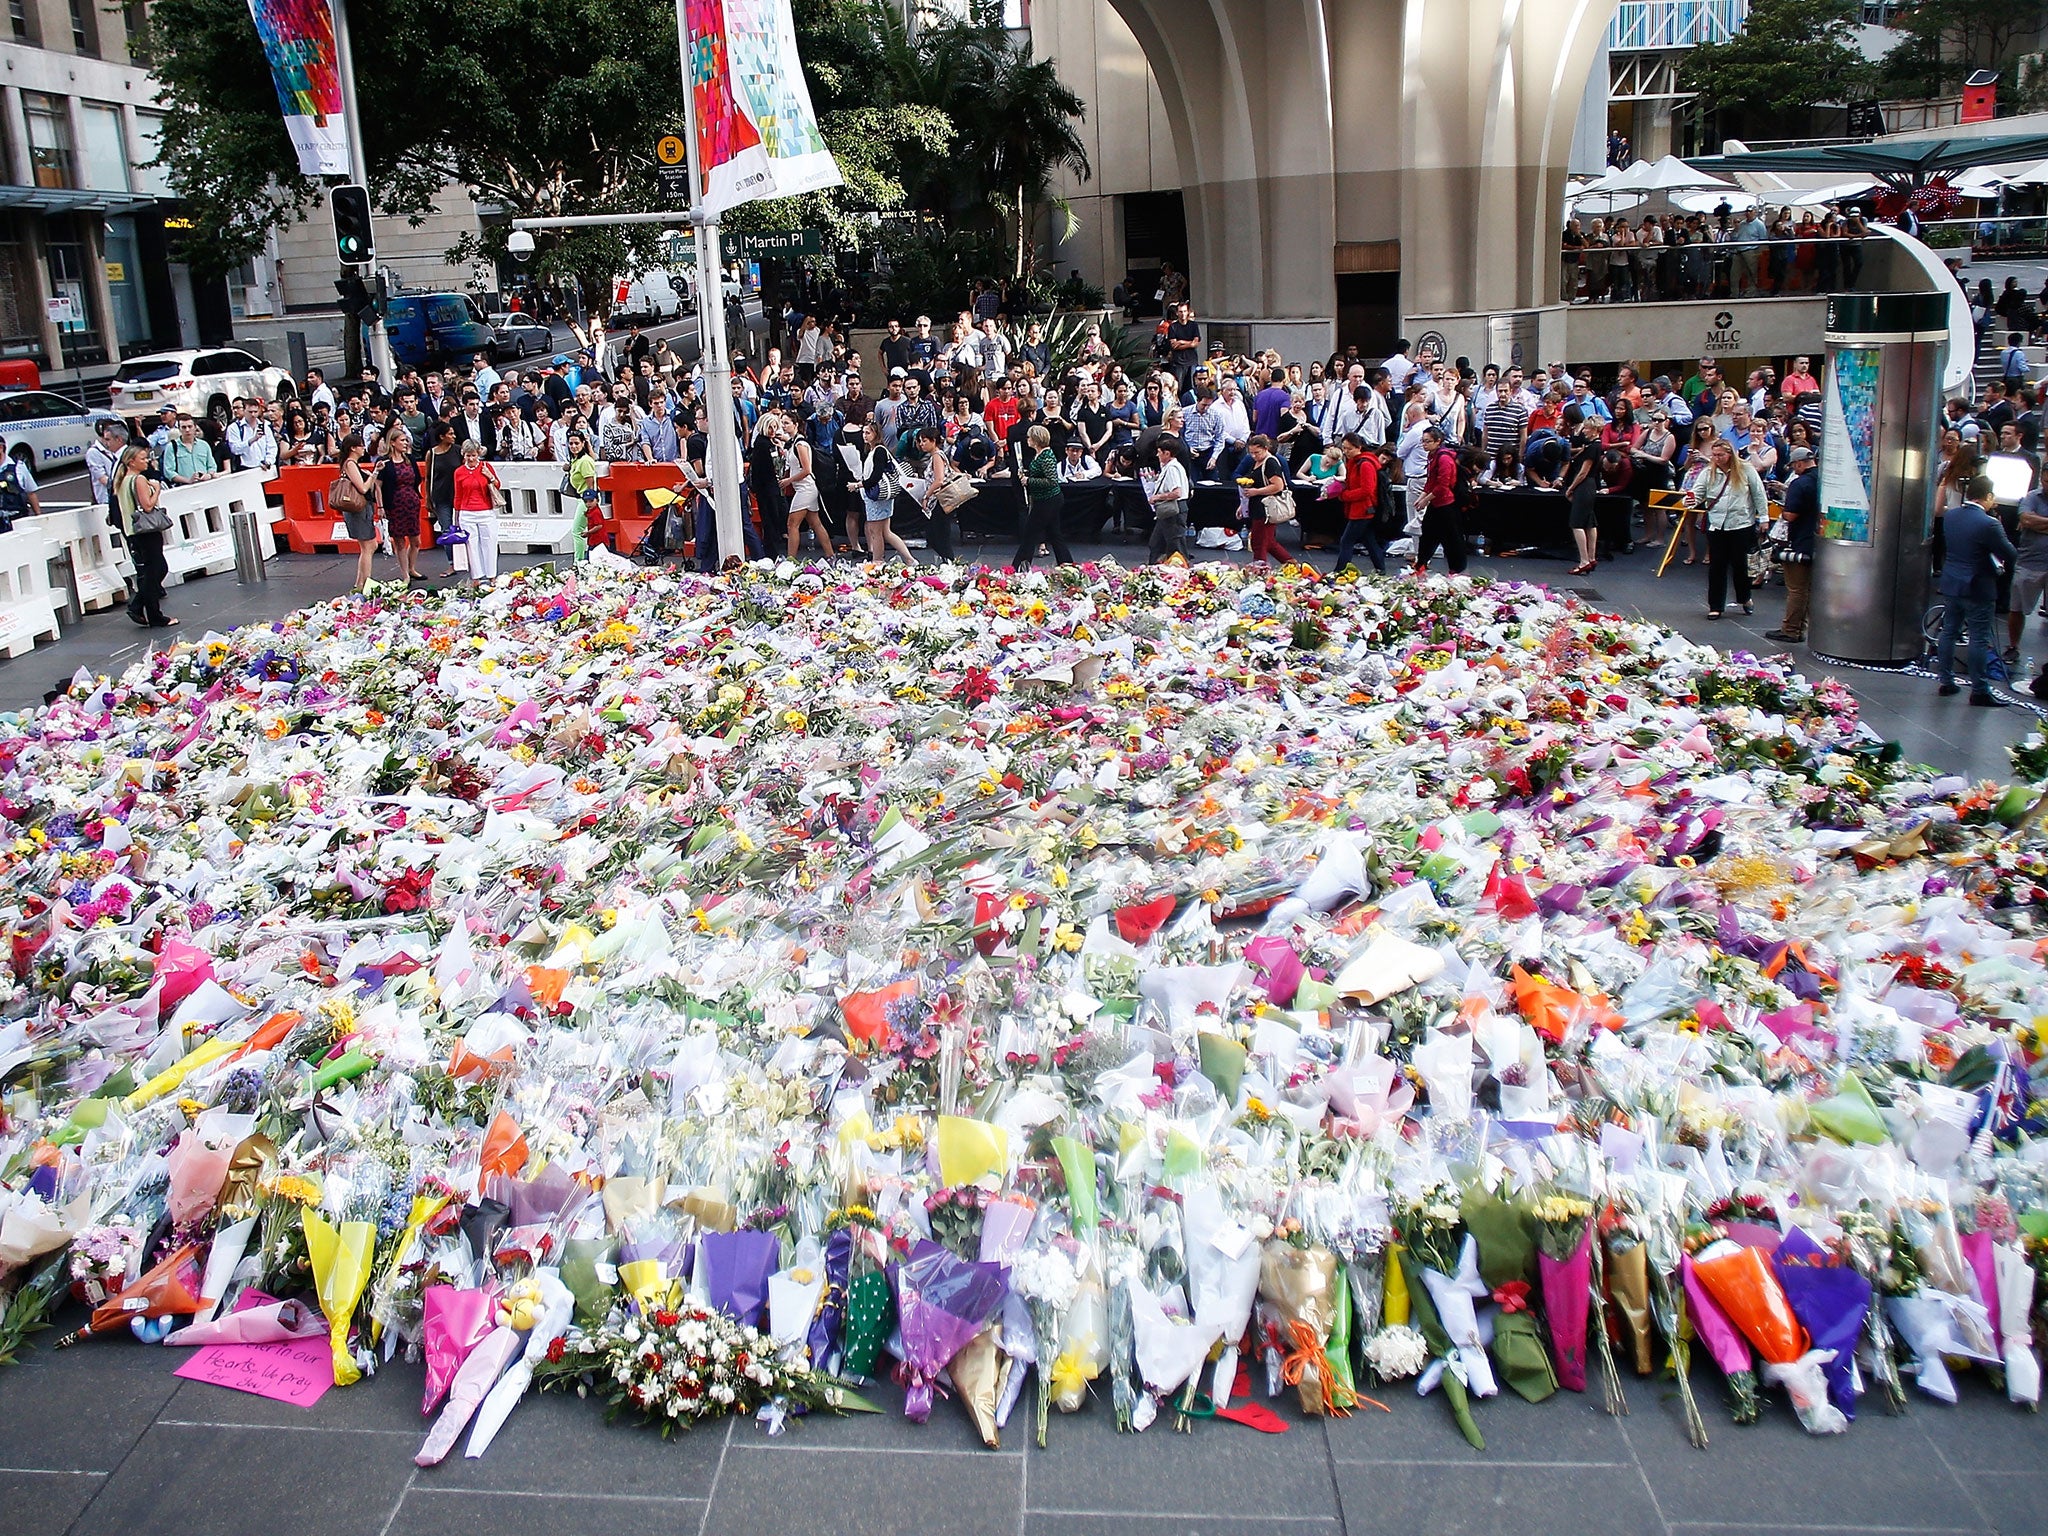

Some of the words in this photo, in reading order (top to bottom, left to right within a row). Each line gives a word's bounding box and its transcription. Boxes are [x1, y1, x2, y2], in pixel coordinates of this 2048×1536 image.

[745, 234, 787, 249] Martin
[791, 232, 804, 247] Pl
[1707, 330, 1741, 342] MLC
[43, 444, 81, 460] Police
[276, 1343, 292, 1357] in
[293, 1351, 322, 1364] our
[277, 1373, 312, 1397] pray
